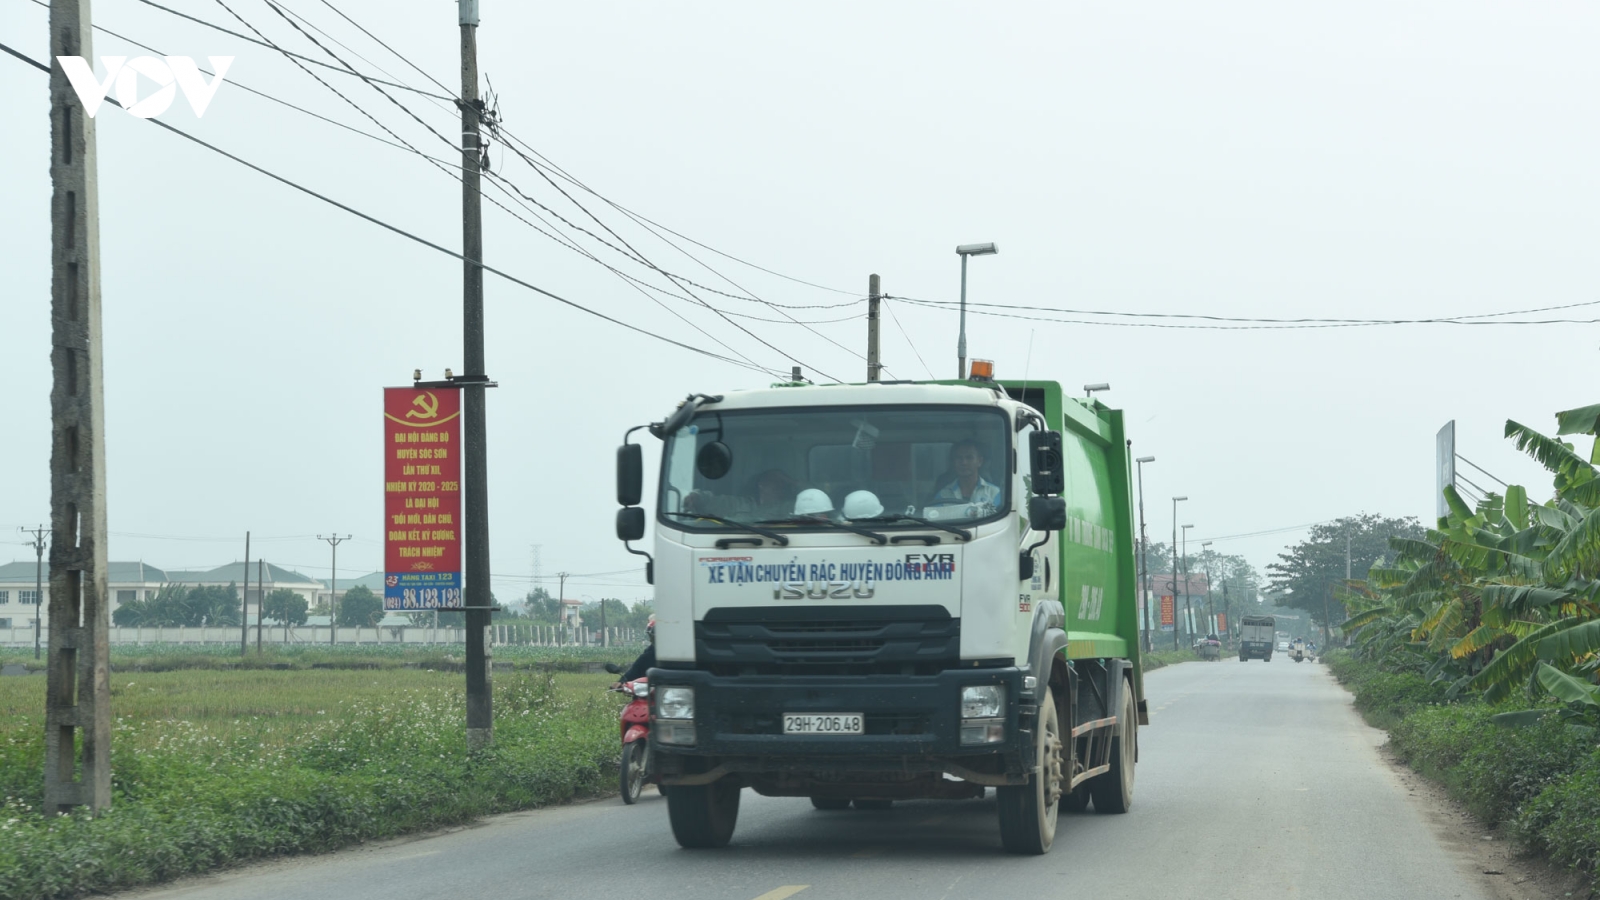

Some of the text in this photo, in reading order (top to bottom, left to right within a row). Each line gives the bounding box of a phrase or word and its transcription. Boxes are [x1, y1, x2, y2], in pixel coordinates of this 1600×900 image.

[395, 430, 449, 444] ĐẠI HỘI ĐẢNG BỘ
[397, 447, 447, 460] HUYỆN SÓC SƠN
[403, 462, 415, 475] LẦN
[416, 464, 430, 475] THỨ
[386, 480, 407, 493] NHIỆM
[408, 480, 417, 492] KỲ
[418, 481, 435, 492] 2020
[441, 481, 458, 491] 2025
[405, 496, 439, 510] LÀ ĐẠI HỘI
[423, 513, 436, 524] DÂN
[389, 529, 406, 541] ĐOÀN
[399, 546, 420, 557] TRÁCH
[905, 554, 955, 563] FVR
[708, 556, 952, 586] XE VẬN CHUYỂN RÁC HUYỆN ĐÔNG ANH
[773, 580, 875, 600] ISUZU
[403, 588, 460, 609] 38.123.123
[786, 717, 860, 731] 29H-206.48
